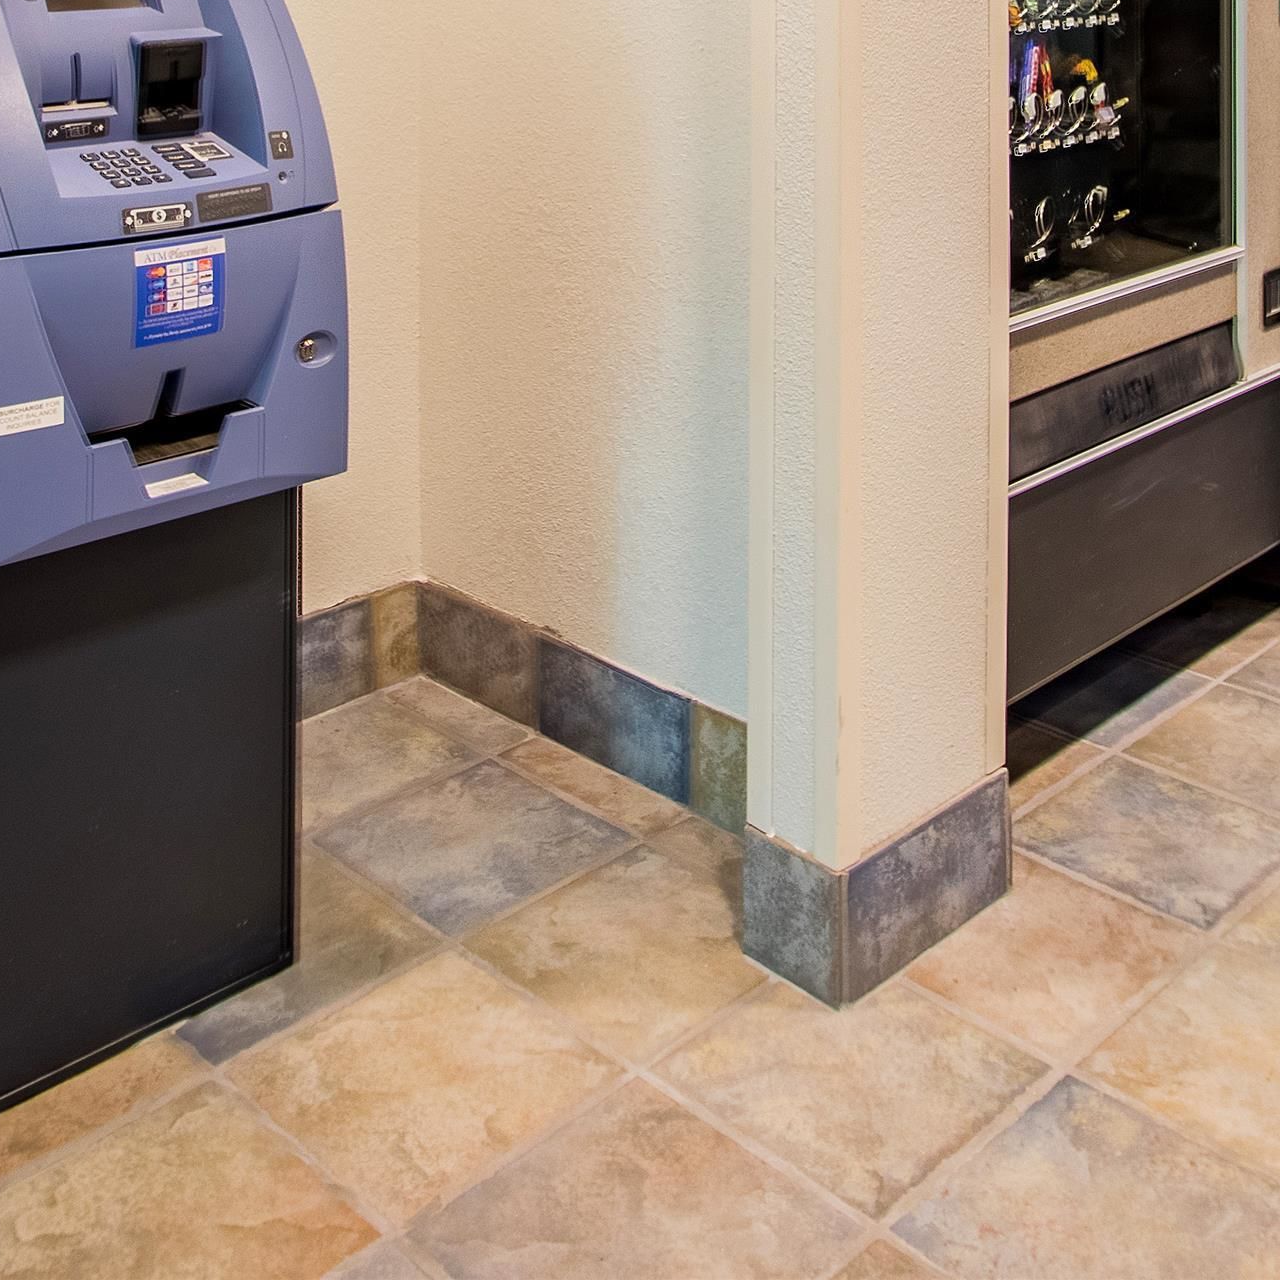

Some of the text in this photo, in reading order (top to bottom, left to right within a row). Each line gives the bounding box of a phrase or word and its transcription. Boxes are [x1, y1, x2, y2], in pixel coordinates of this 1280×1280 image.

[144, 250, 167, 264] ATM
[1099, 373, 1157, 423] PUSH
[0, 403, 44, 417] SURCHARGE
[25, 407, 58, 419] BALANCE
